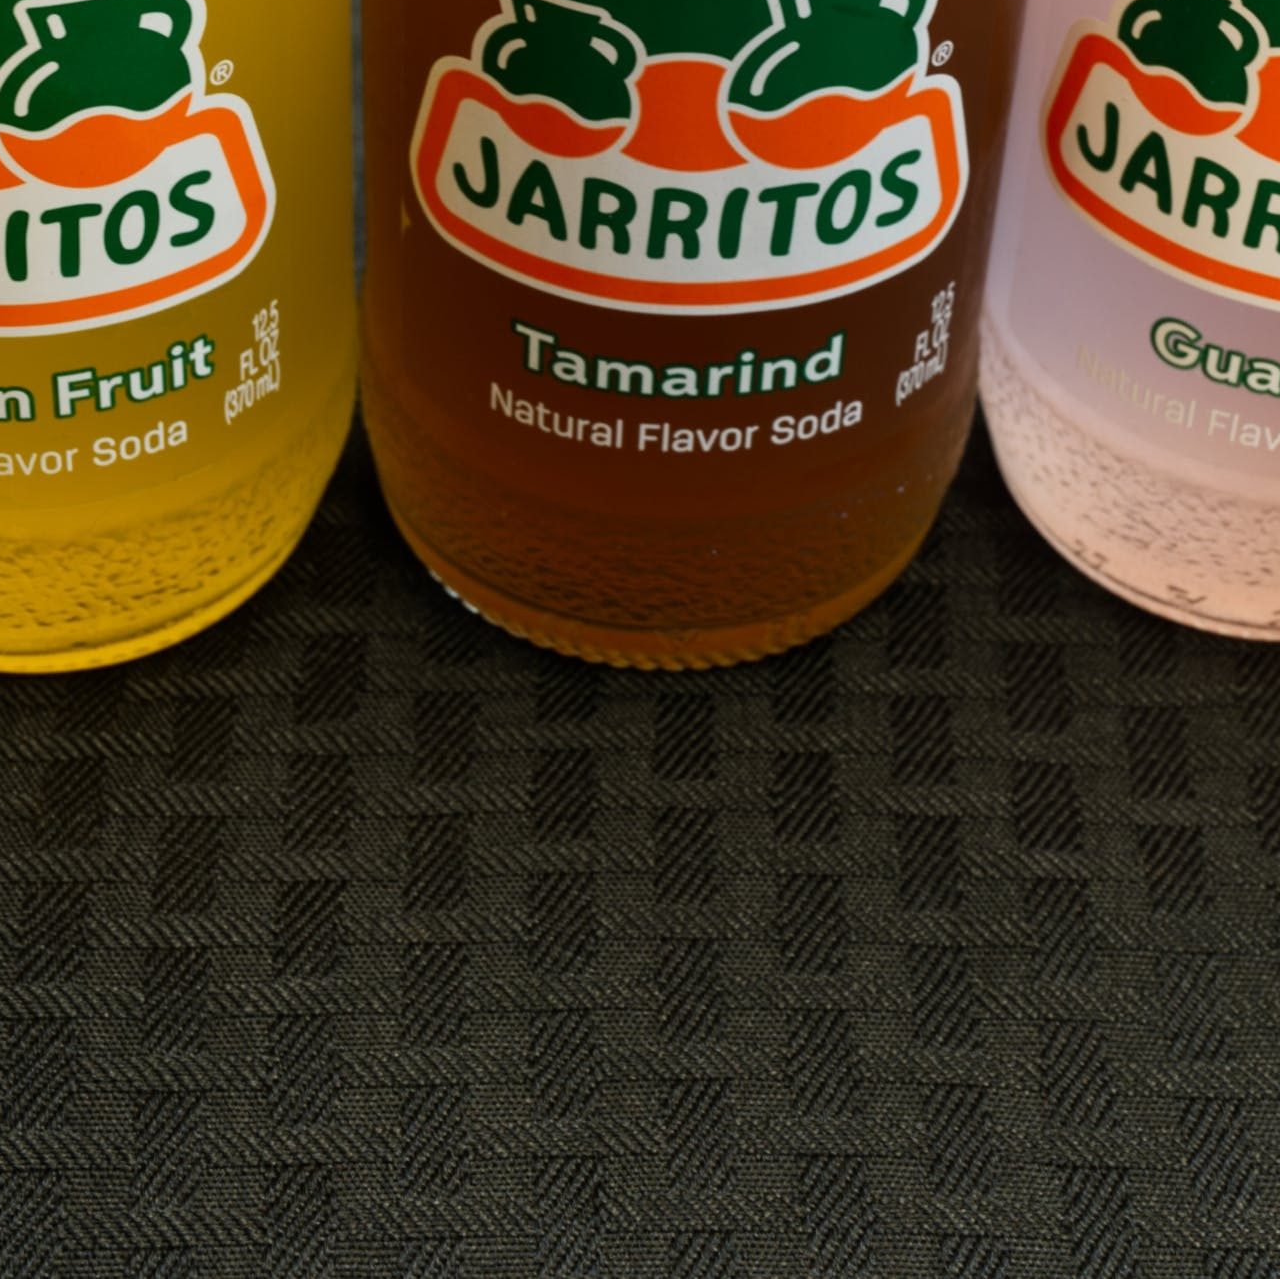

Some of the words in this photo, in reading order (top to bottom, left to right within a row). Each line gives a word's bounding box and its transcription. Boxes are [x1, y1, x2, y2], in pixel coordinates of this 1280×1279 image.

[452, 135, 922, 260] JARRITOS
[52, 334, 215, 418] Fruit
[239, 348, 259, 381] FL
[513, 322, 845, 397] Tamarind
[1077, 342, 1198, 429] Natural
[92, 420, 189, 467] Soda
[489, 381, 624, 450] Natural
[637, 422, 760, 454] Flavor
[770, 400, 864, 446] Soda
